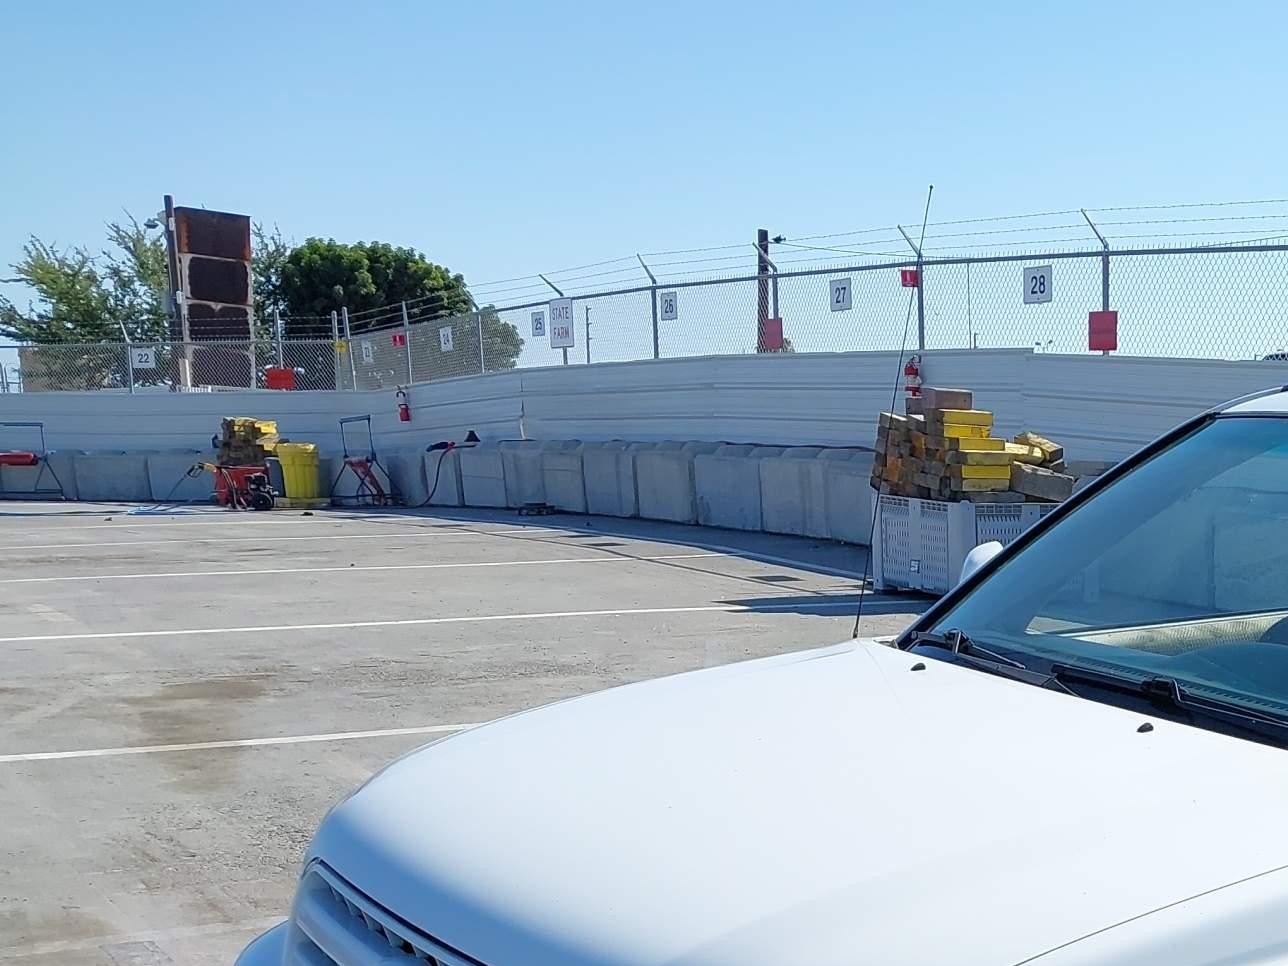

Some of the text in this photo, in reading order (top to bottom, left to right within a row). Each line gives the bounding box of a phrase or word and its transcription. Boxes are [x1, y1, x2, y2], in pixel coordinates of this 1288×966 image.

[1030, 274, 1046, 295] 28
[834, 286, 847, 304] 27
[551, 306, 570, 321] STATE
[664, 299, 674, 315] 26
[534, 317, 543, 331] 25
[553, 326, 570, 340] FARM
[137, 353, 150, 364] 22
